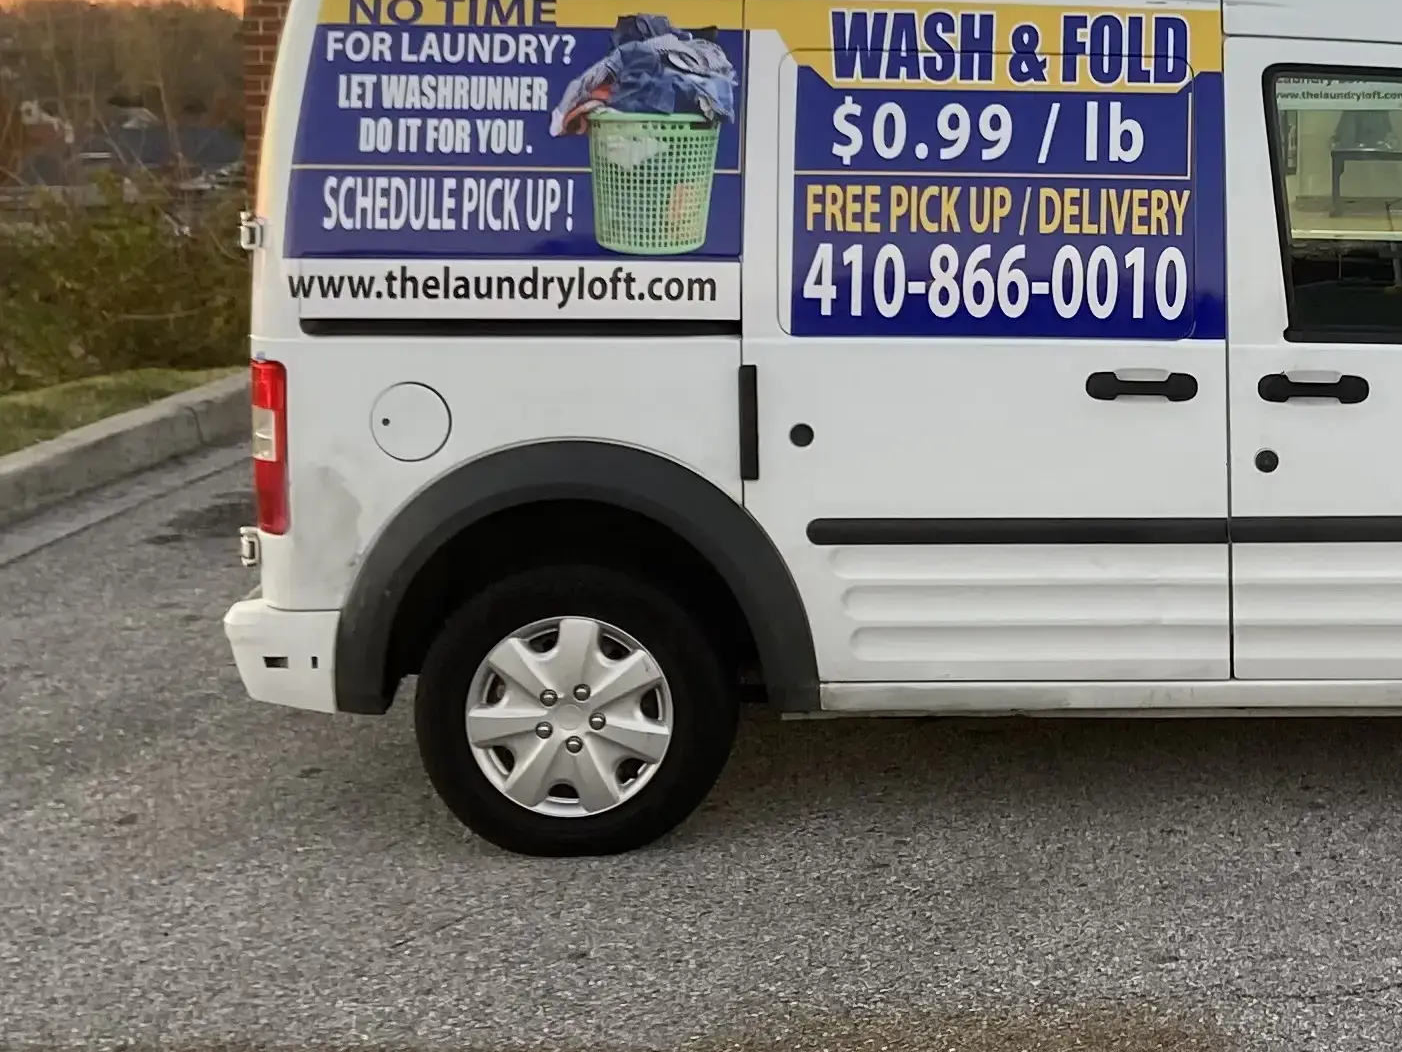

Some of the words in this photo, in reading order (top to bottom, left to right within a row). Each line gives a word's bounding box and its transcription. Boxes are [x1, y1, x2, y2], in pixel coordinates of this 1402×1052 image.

[326, 31, 392, 63] FOR
[401, 31, 576, 65] LAUNDRY?
[830, 9, 996, 85] WASH
[1007, 22, 1050, 87] &
[1060, 13, 1192, 86] FOLD
[338, 74, 375, 109] LET
[382, 74, 549, 111] WASHRUNNER
[359, 117, 394, 153] DO
[397, 118, 424, 153] IT
[427, 118, 471, 153] FOR
[476, 119, 533, 155] YOU.
[831, 96, 1014, 166] $0.99
[1037, 102, 1060, 164] /
[1084, 101, 1145, 164] lb
[322, 176, 457, 231] SCHEDULE
[462, 178, 518, 231] PICK
[806, 184, 882, 233] FREE
[890, 184, 962, 234] PICK
[969, 185, 1012, 234] UP
[1018, 186, 1033, 236] /
[1038, 188, 1191, 237] DELIVERY
[288, 267, 718, 310] www.thelaundryloft.com
[802, 243, 1188, 320] 410-866-0010
